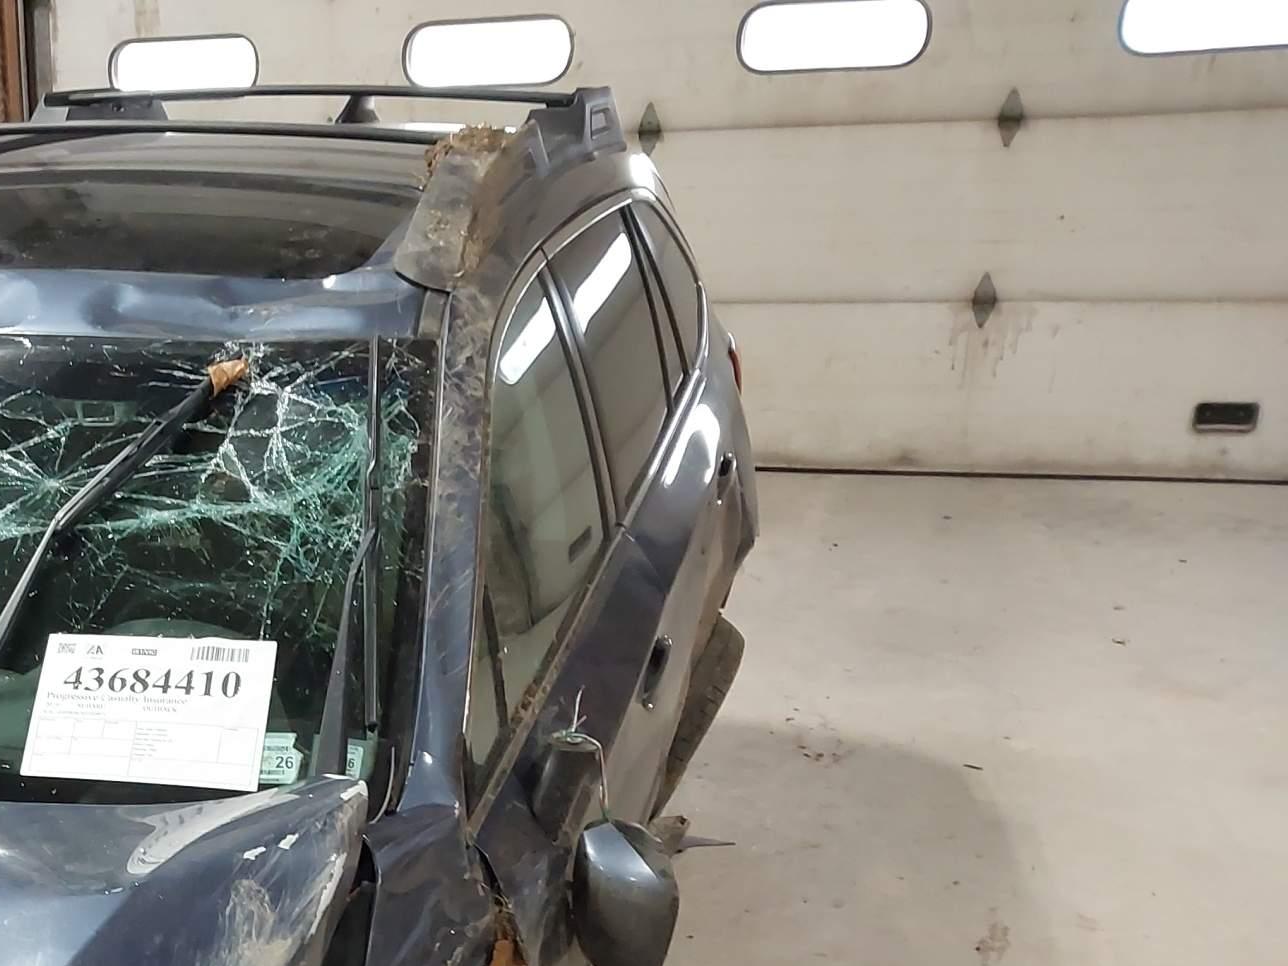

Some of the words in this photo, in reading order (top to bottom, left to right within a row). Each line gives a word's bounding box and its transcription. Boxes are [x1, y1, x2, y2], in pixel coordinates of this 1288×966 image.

[63, 665, 242, 698] 43684410
[47, 691, 99, 702] Progressive
[101, 693, 139, 704] Casualty
[143, 695, 188, 704] Insurance
[275, 756, 294, 769] 26
